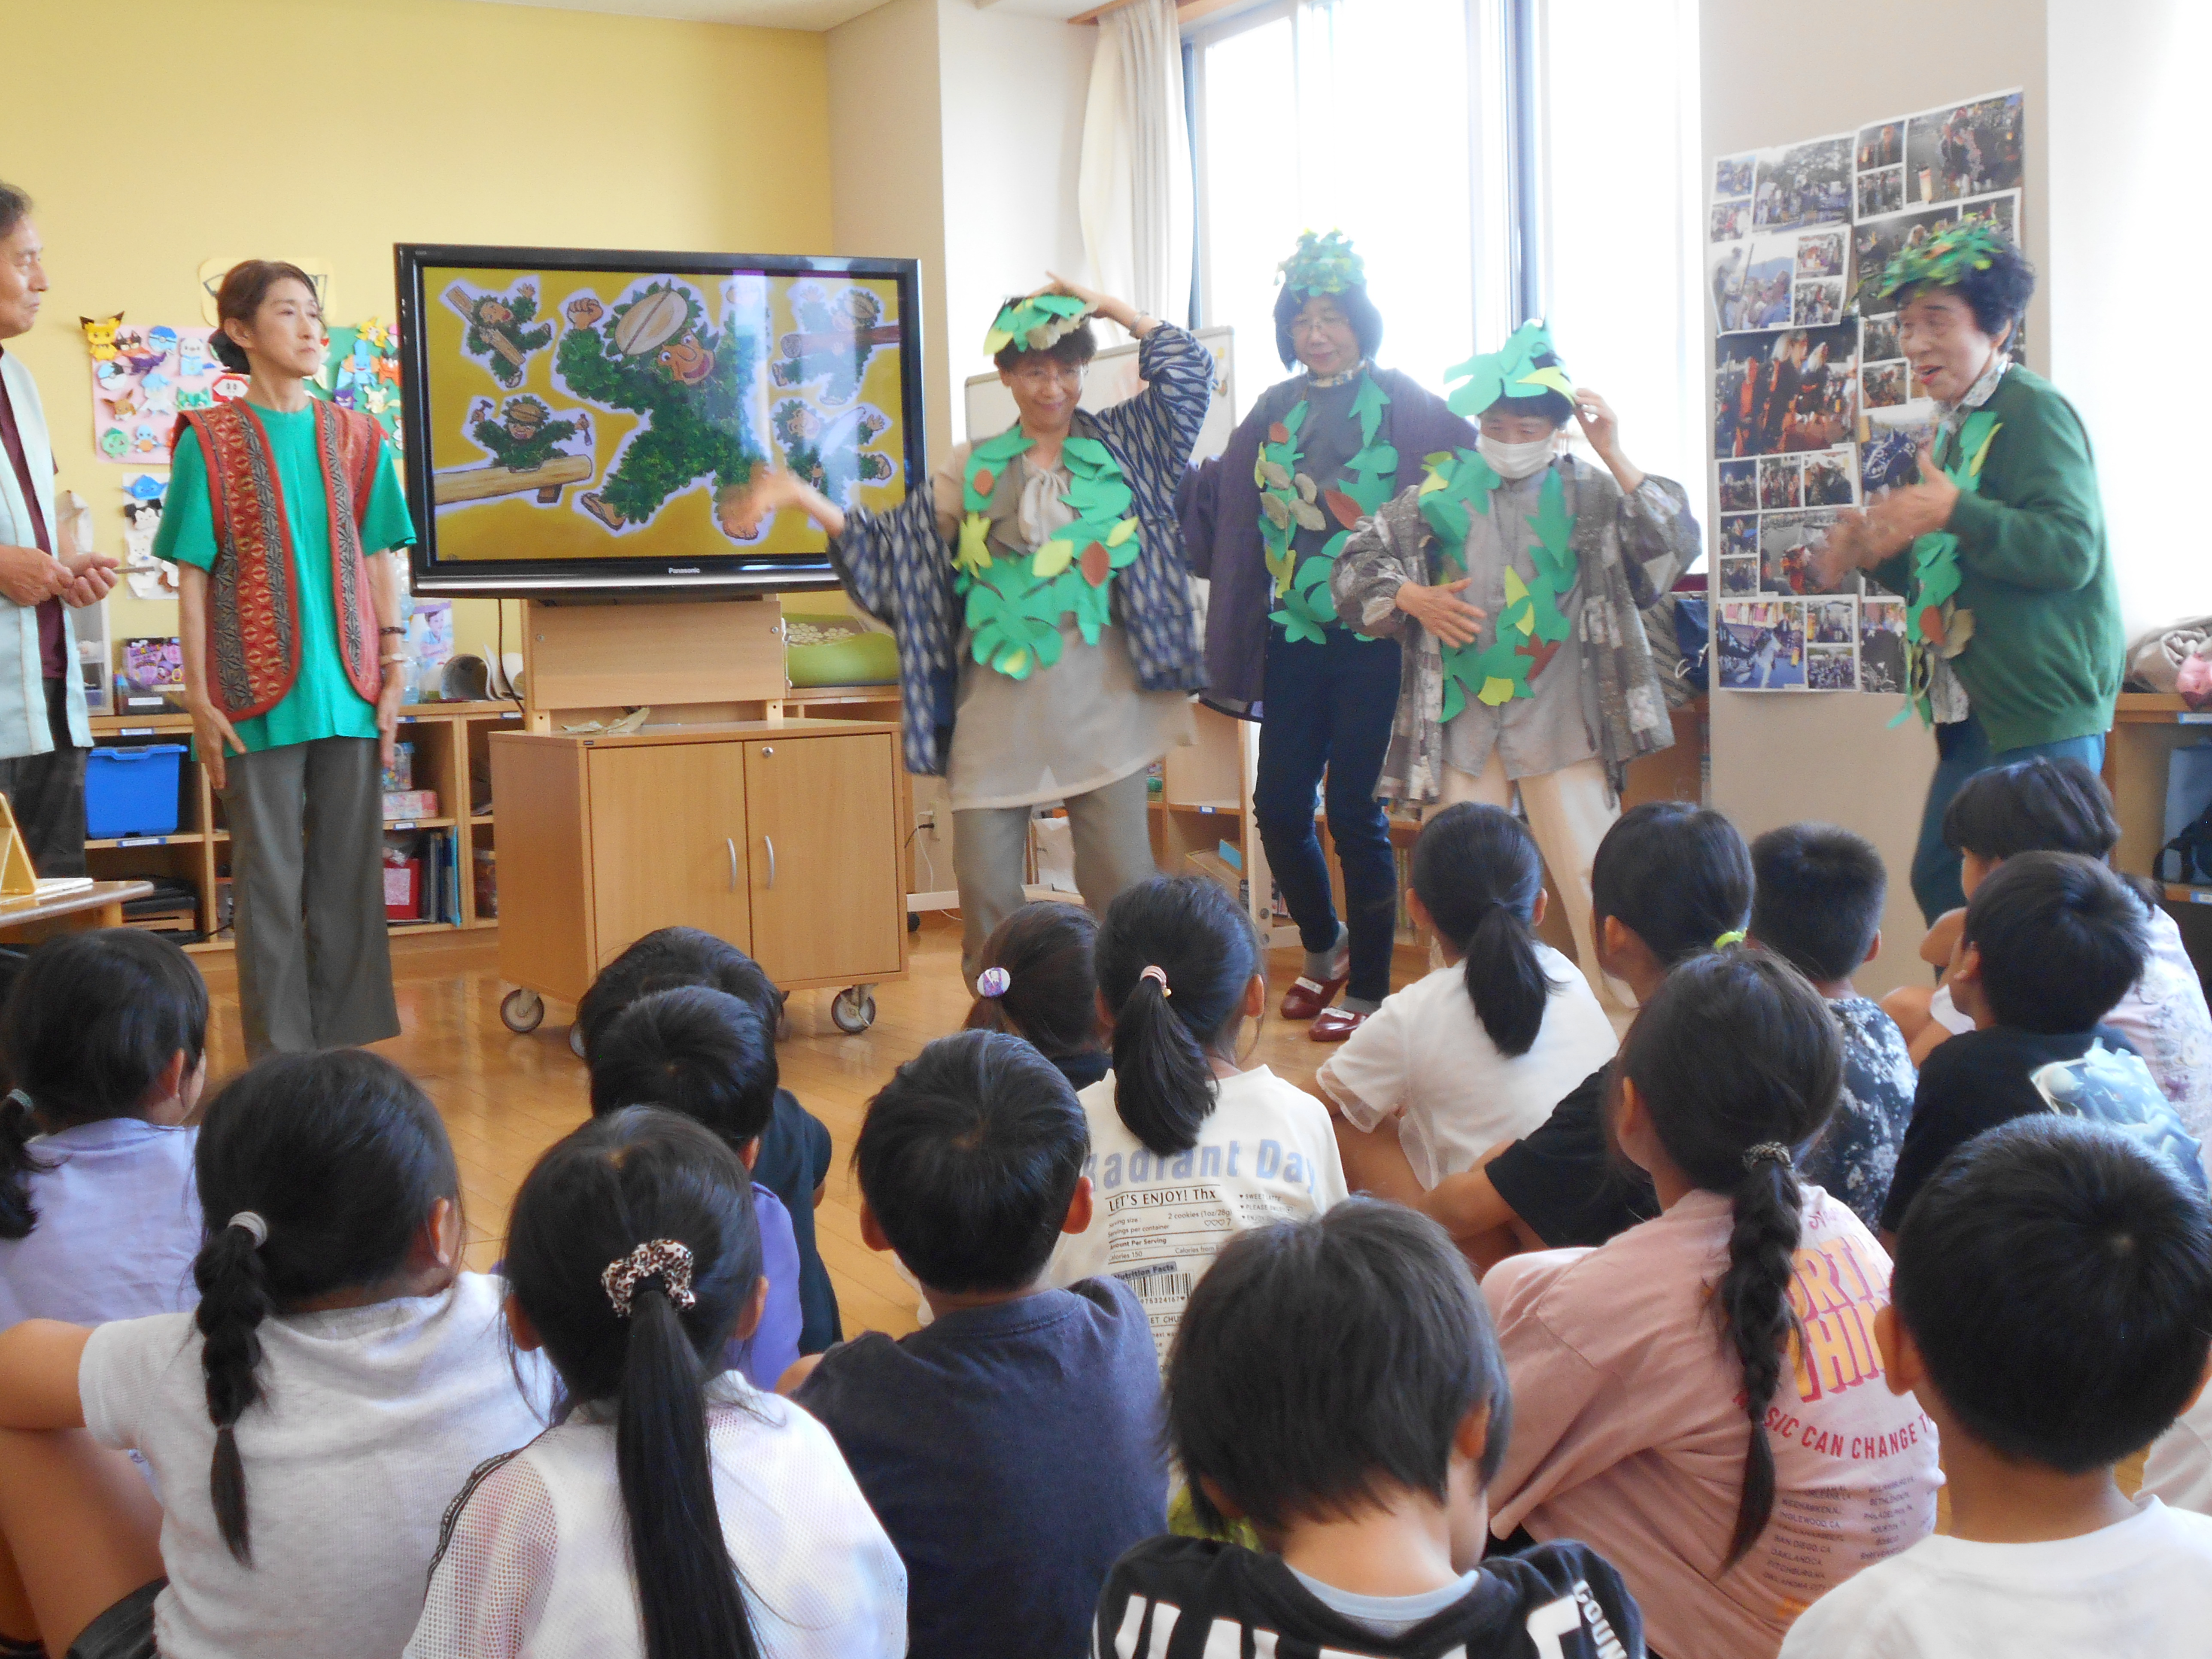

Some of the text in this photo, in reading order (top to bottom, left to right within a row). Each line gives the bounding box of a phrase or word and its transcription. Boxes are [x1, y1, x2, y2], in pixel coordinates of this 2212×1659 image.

[1109, 1188, 1216, 1212] LET'S ENJOY! Thx
[1201, 1209, 1232, 1218] (1oz/28g)
[1226, 1218, 1231, 1226] 7
[1153, 1265, 1174, 1273] Facts
[1802, 1425, 1844, 1458] CAN
[1851, 1422, 1917, 1459] CHANGE
